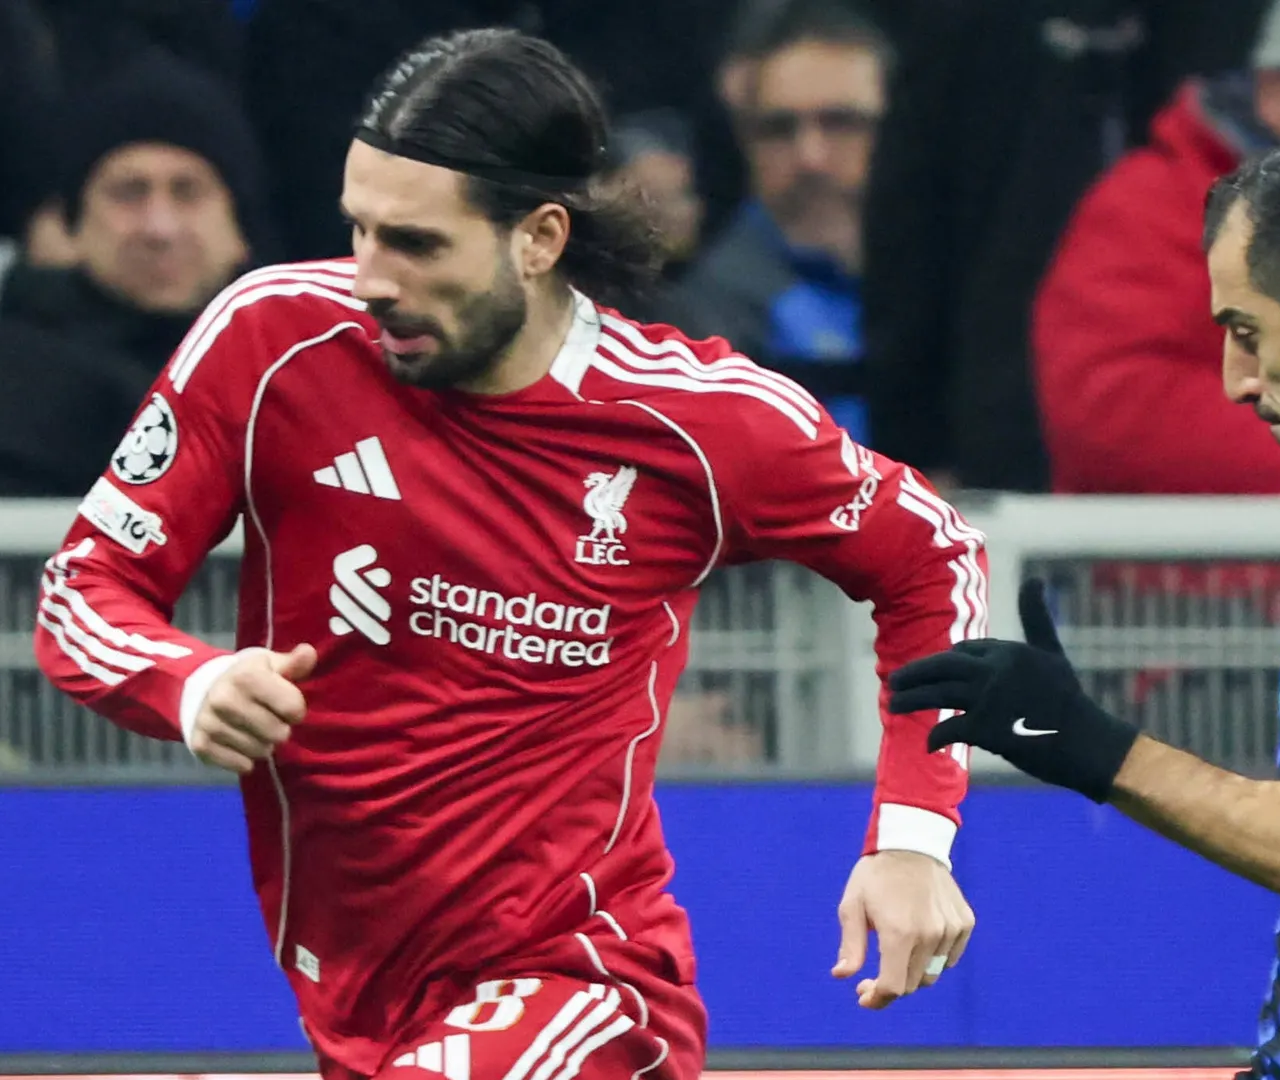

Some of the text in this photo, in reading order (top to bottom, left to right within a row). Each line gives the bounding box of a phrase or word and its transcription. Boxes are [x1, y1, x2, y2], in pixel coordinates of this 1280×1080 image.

[409, 574, 611, 635] standard
[409, 609, 615, 667] chartered
[443, 977, 543, 1032] 8
